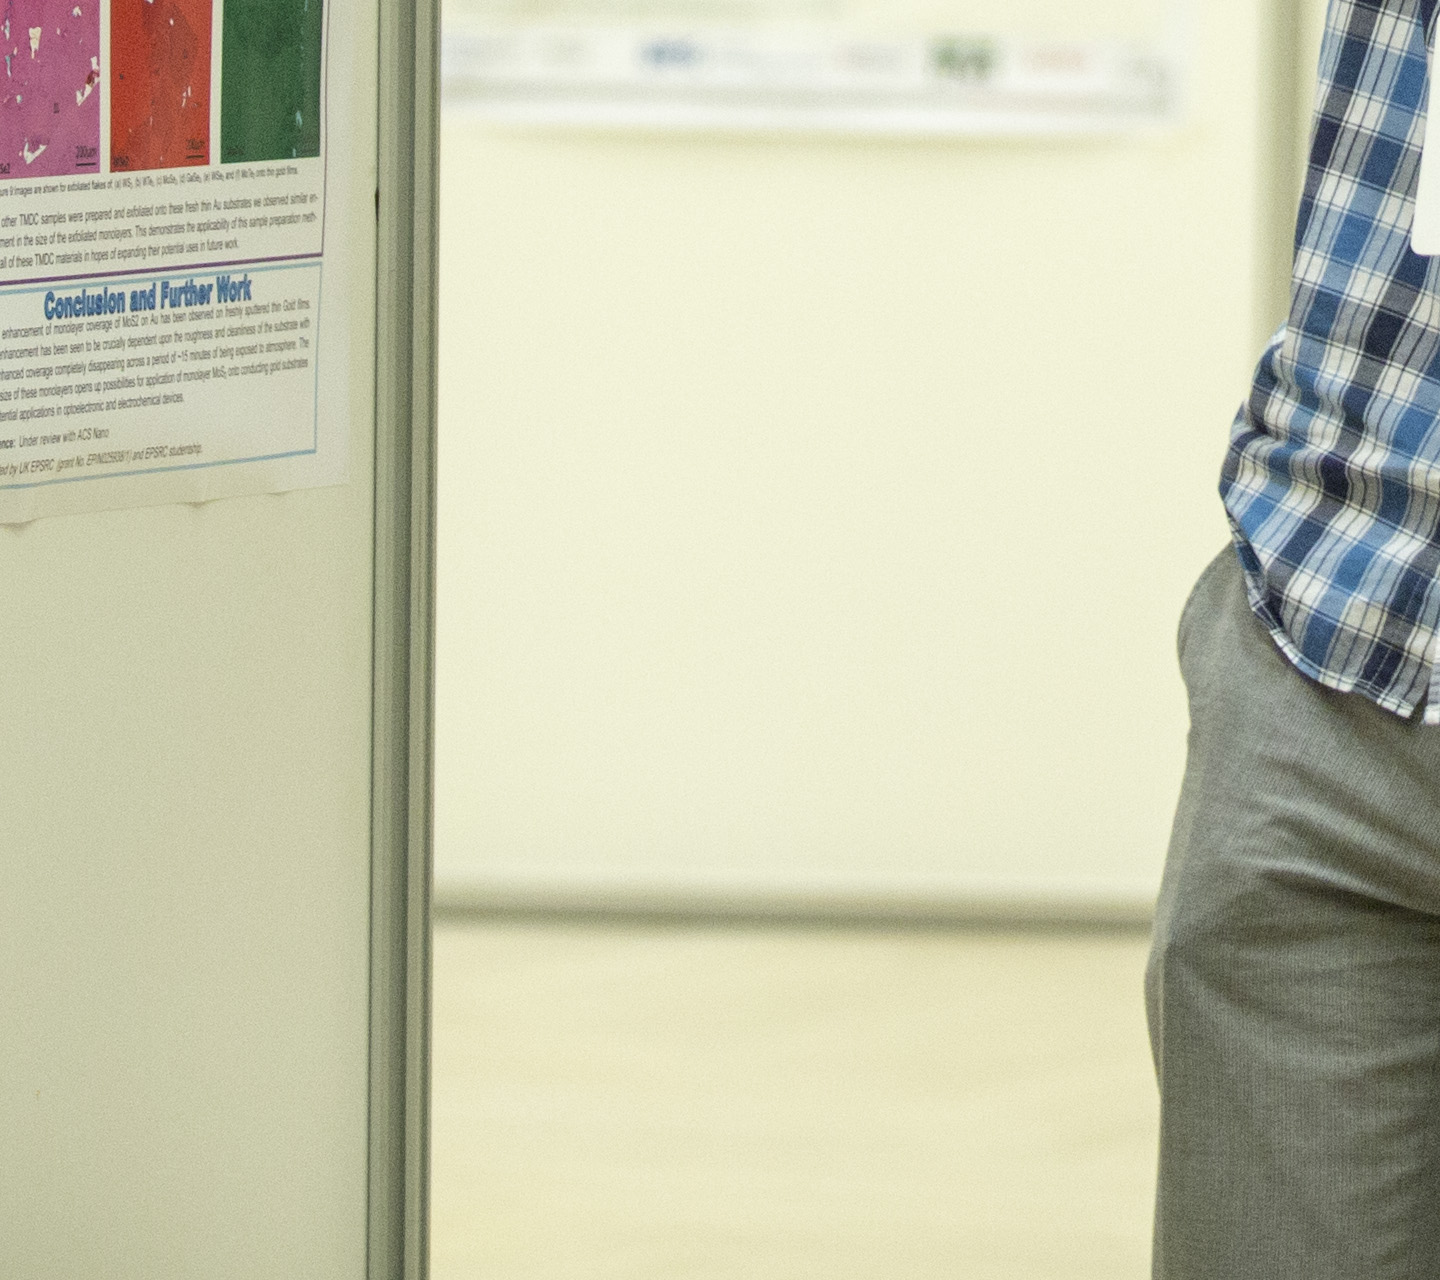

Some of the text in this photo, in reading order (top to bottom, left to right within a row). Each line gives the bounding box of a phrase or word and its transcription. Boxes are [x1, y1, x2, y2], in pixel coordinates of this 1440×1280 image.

[44, 274, 253, 320] Conclusion and Further Work
